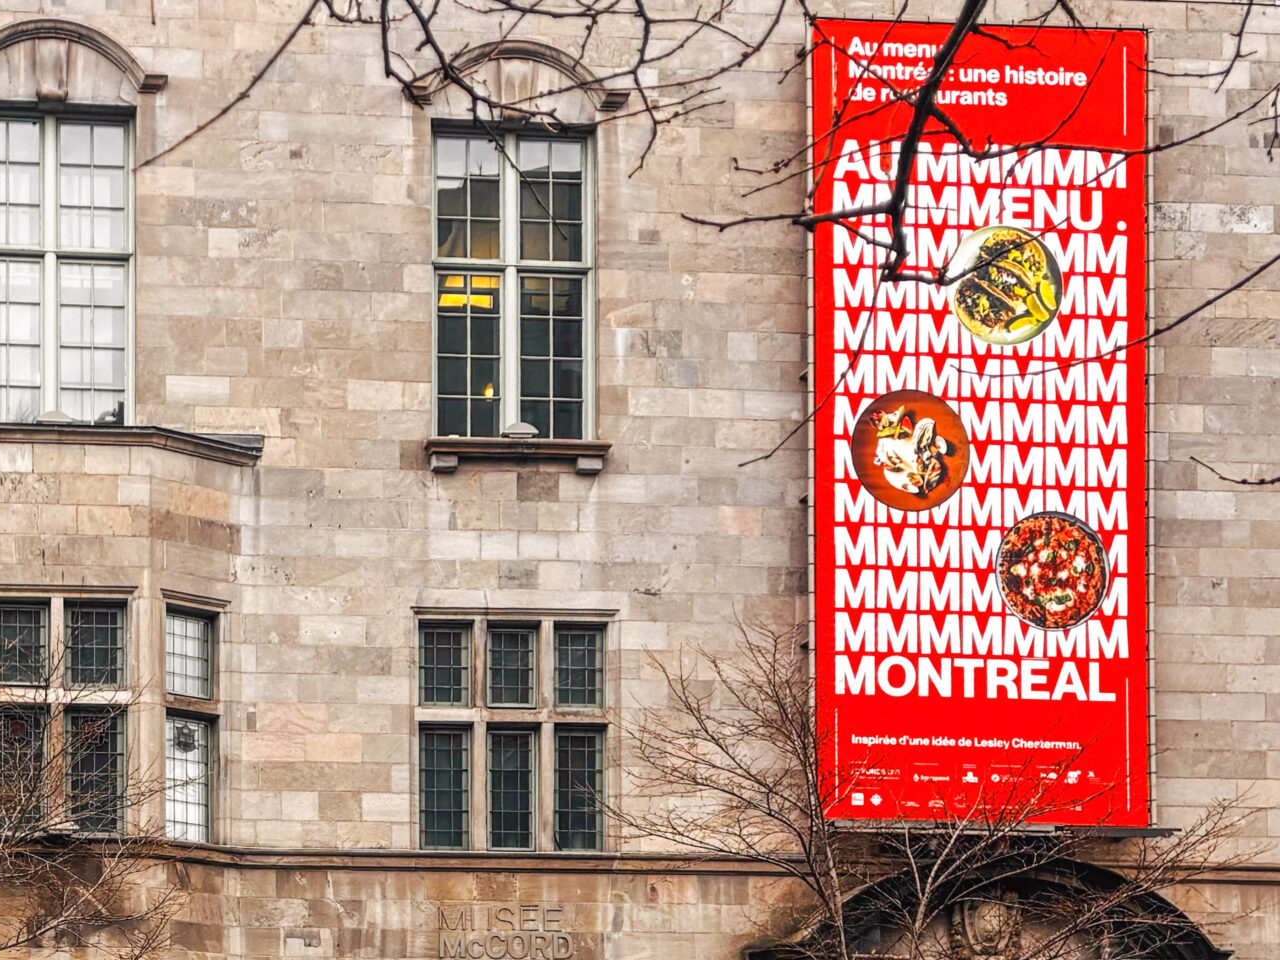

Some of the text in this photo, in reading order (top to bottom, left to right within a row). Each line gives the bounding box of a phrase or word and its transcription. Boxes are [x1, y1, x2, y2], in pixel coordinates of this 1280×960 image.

[848, 37, 878, 57] Au
[960, 67, 1001, 84] une
[1005, 66, 1088, 87] histoire
[848, 82, 877, 102] de
[833, 139, 902, 182] AU
[898, 735, 930, 746] d'une
[958, 737, 972, 747] de
[974, 737, 1010, 749] Lesley
